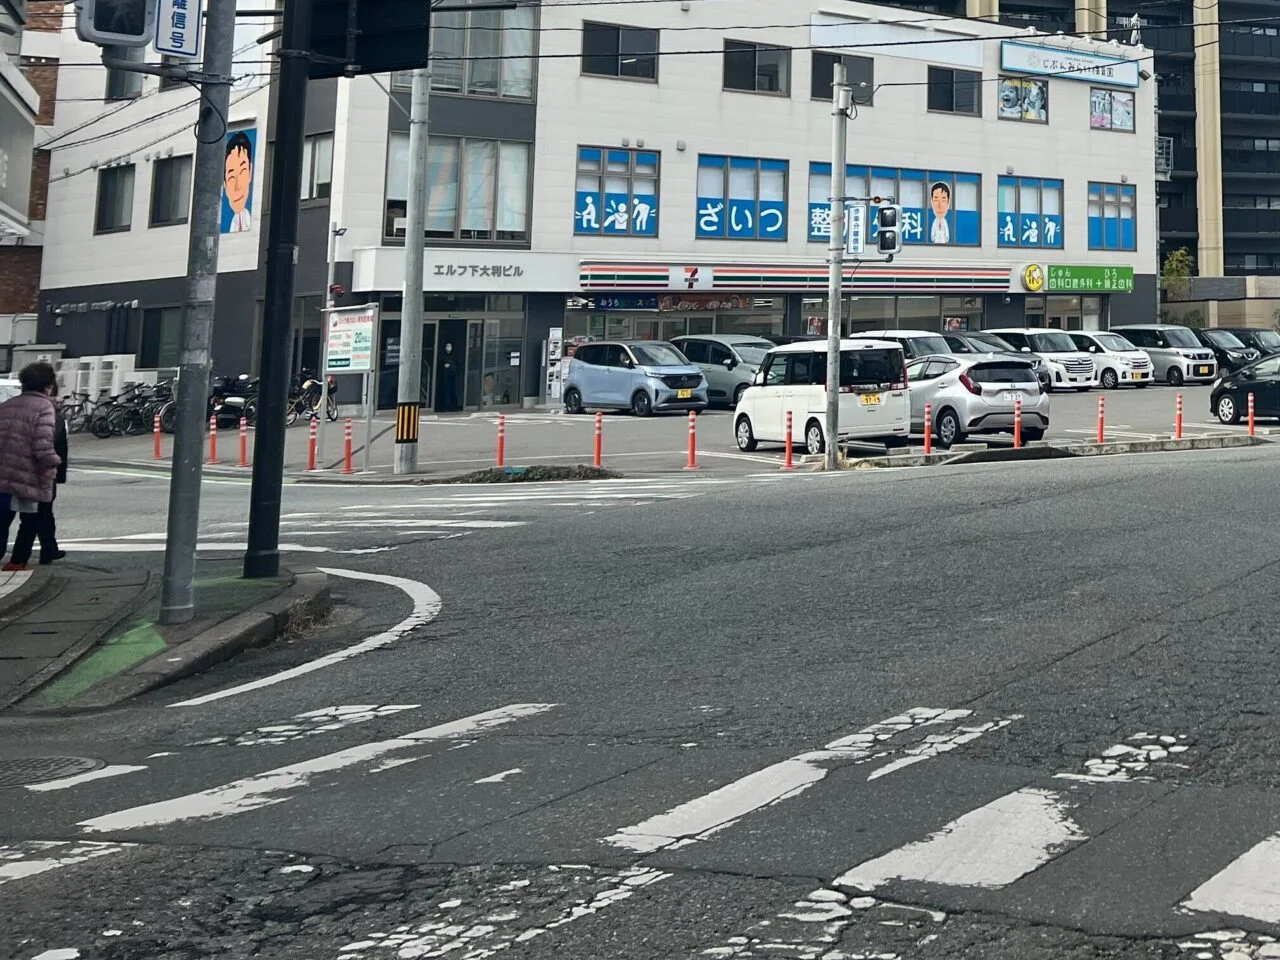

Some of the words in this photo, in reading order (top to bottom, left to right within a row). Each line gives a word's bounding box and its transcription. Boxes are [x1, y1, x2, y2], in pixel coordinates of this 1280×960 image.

[699, 202, 784, 232] ざいつ
[433, 264, 524, 278] エルフ下大利ビル
[1104, 268, 1118, 279] ひろ
